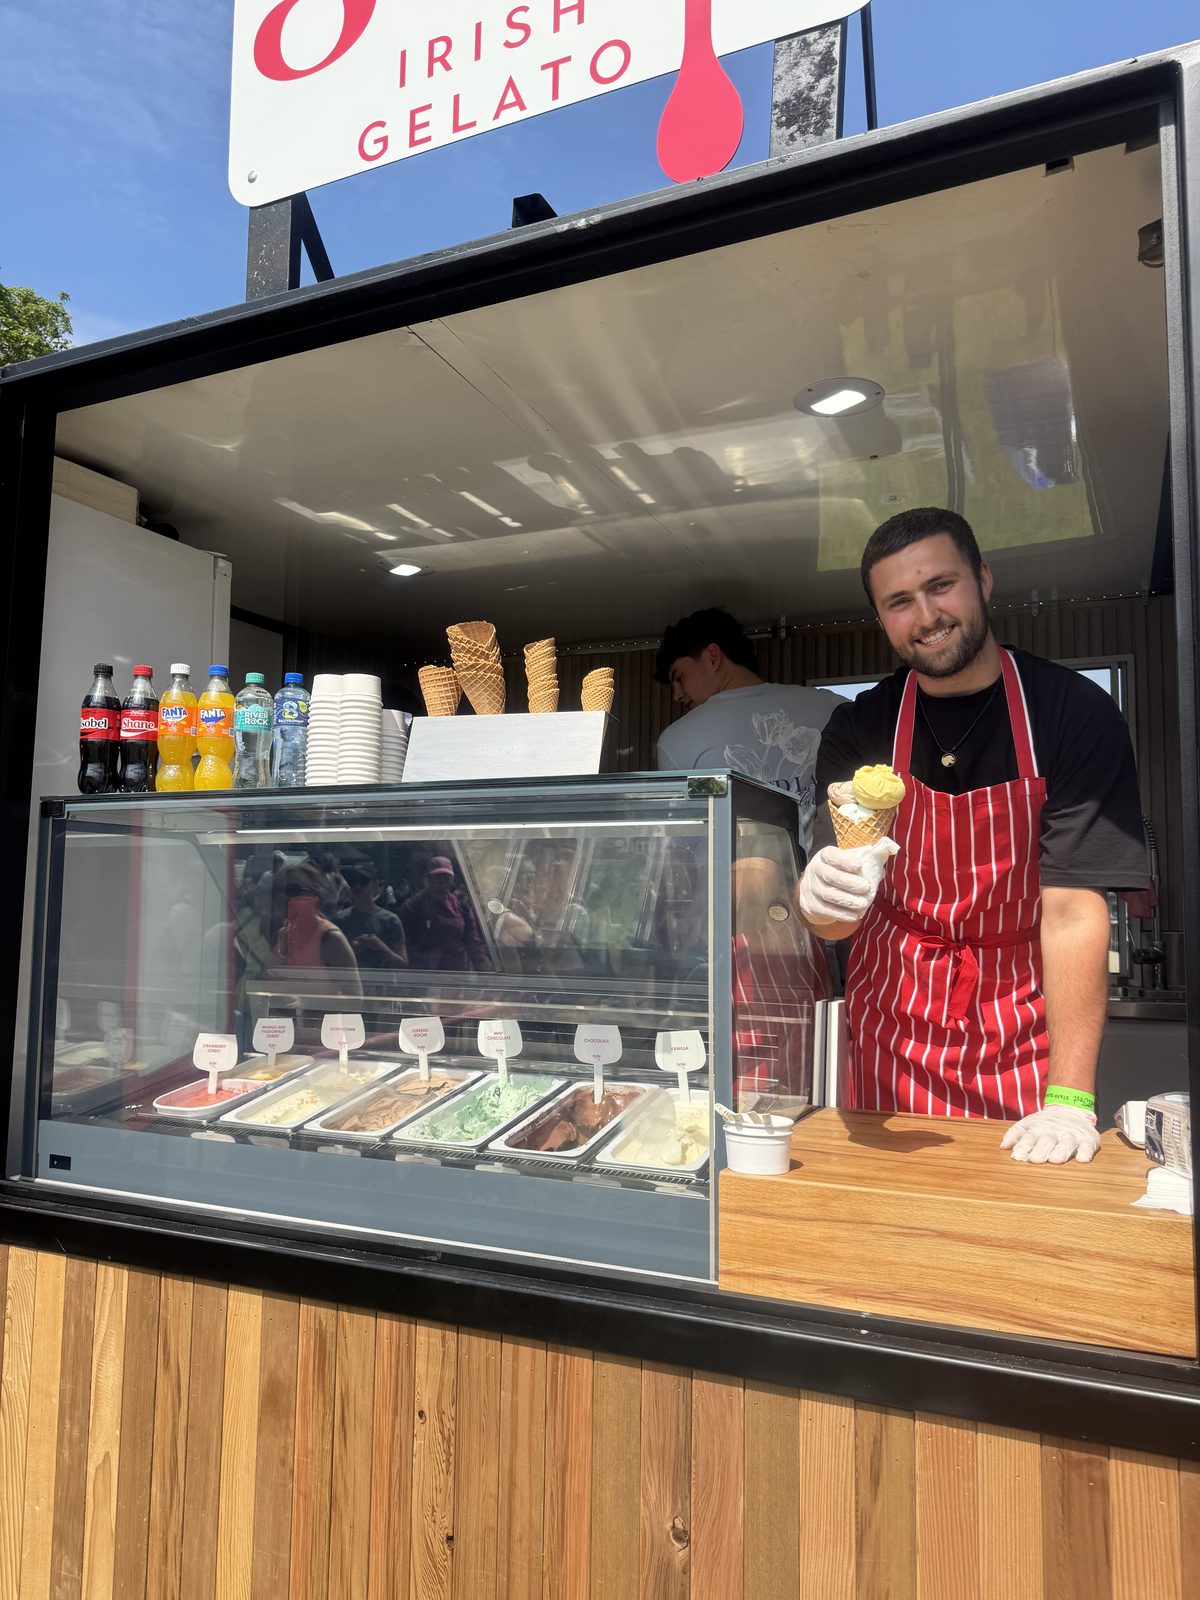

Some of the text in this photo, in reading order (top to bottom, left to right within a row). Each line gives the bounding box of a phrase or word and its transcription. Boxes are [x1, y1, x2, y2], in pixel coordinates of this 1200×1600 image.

[399, 0, 585, 88] IRISH
[358, 39, 632, 162] GELATO
[162, 706, 188, 717] FANTA
[200, 708, 226, 719] FANTA
[244, 711, 268, 719] RIVER
[80, 717, 108, 729] sobel
[122, 717, 155, 730] Shane
